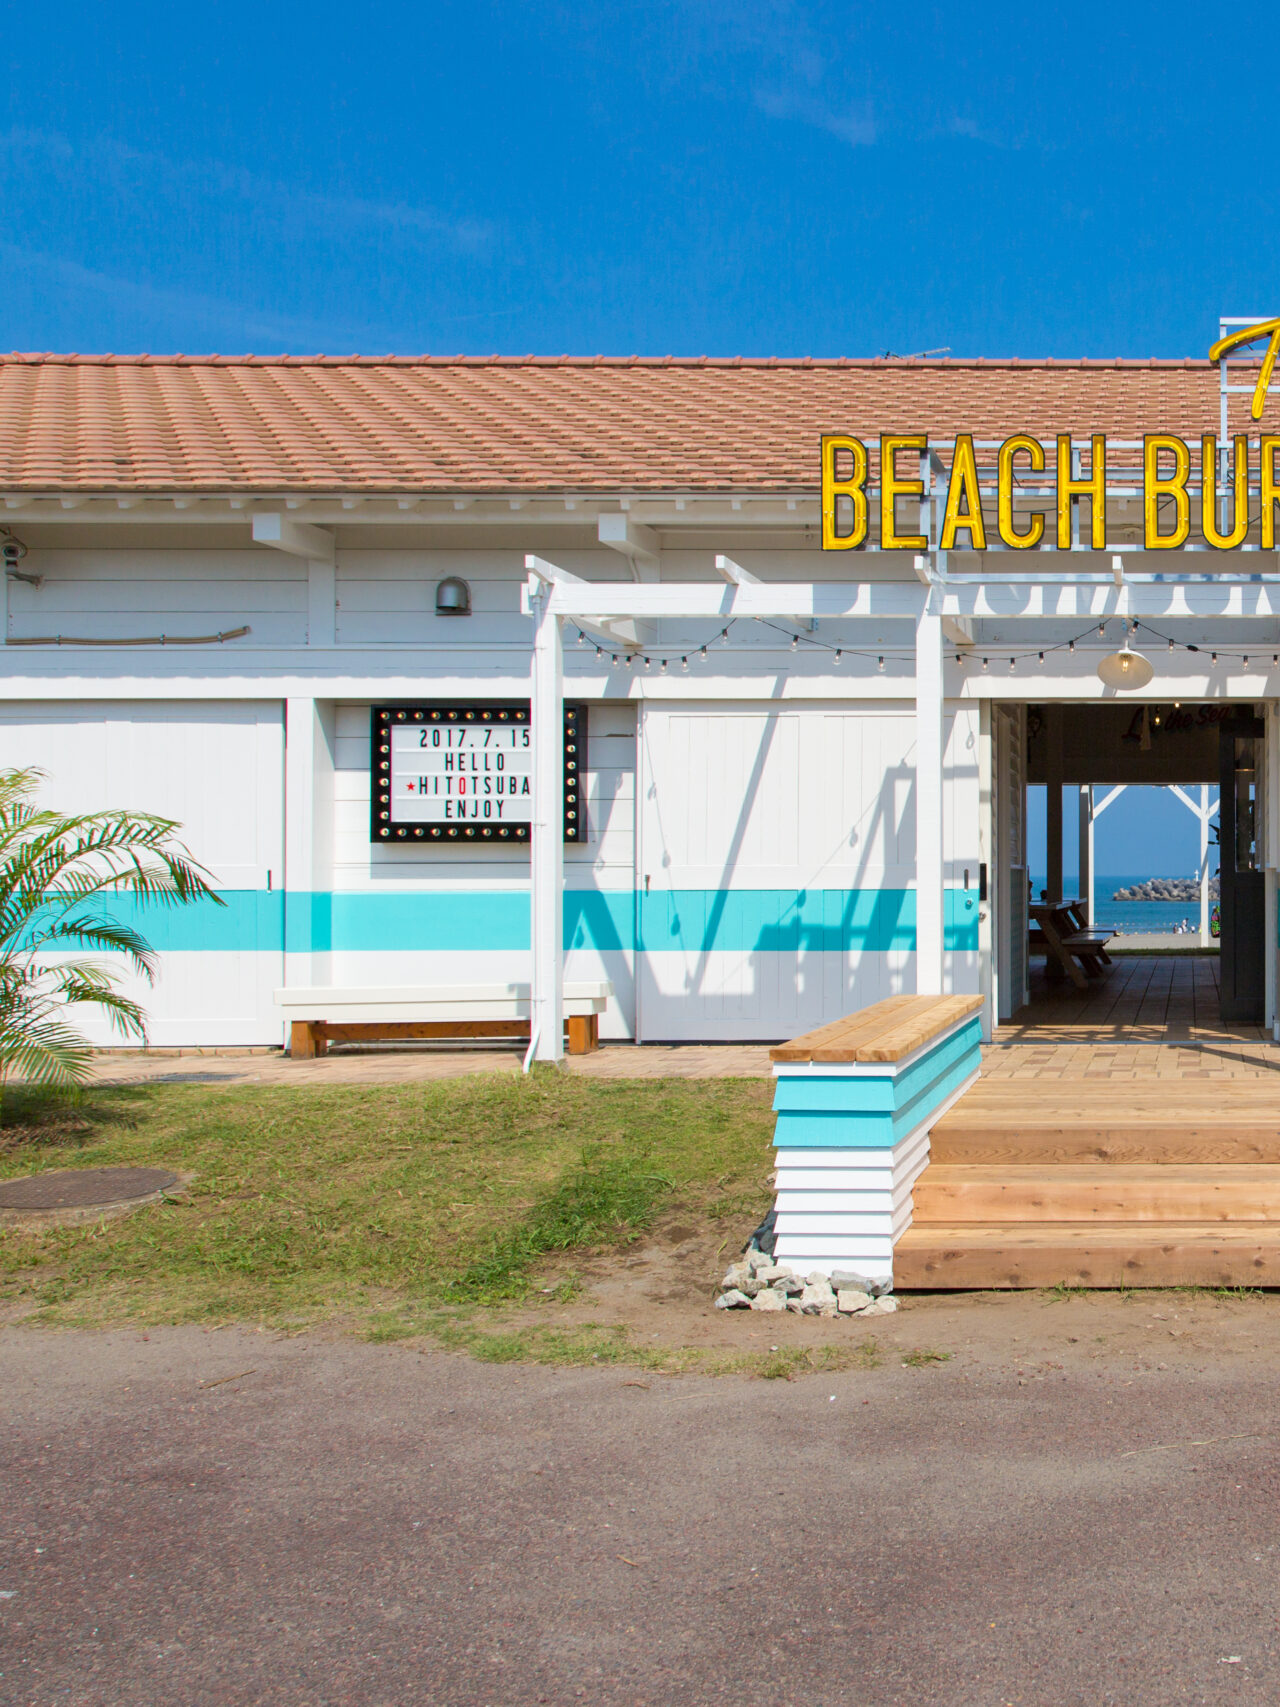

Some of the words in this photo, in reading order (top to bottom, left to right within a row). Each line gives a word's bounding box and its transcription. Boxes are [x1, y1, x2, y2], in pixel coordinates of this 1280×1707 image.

[820, 434, 1107, 551] BEACH
[445, 753, 505, 771] HELLO
[419, 776, 530, 795] HITOTSUBA
[445, 800, 505, 818] ENJOY
